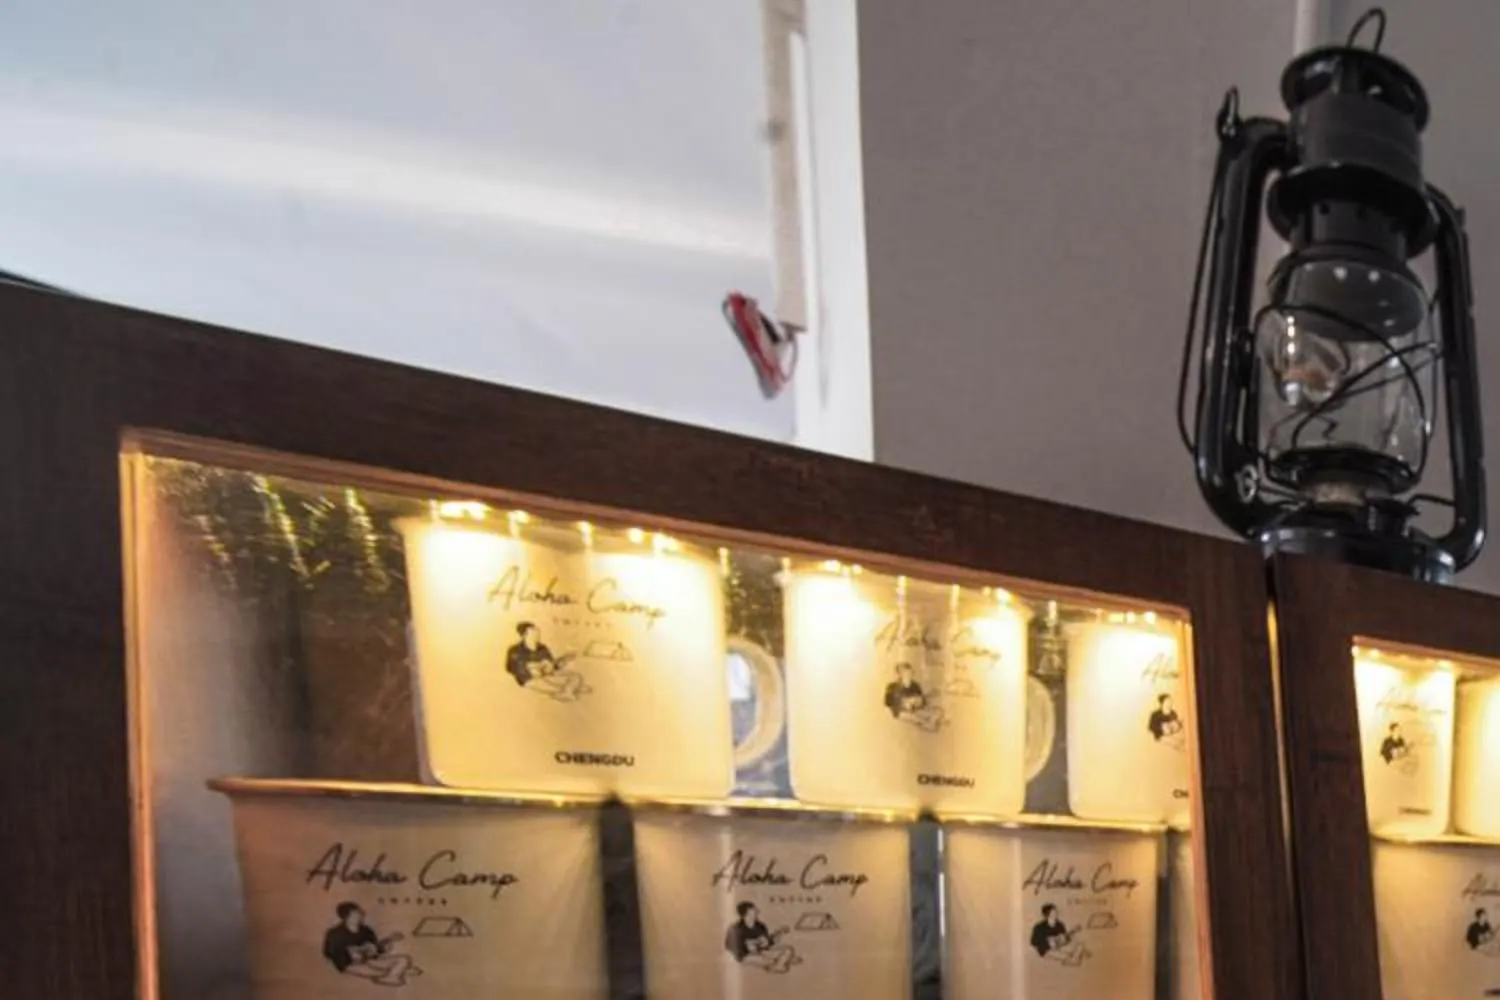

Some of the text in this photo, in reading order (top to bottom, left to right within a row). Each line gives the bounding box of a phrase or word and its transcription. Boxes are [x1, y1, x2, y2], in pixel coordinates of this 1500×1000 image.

[306, 842, 519, 900] Aloha Camp
[711, 849, 869, 898] Aloha Camp
